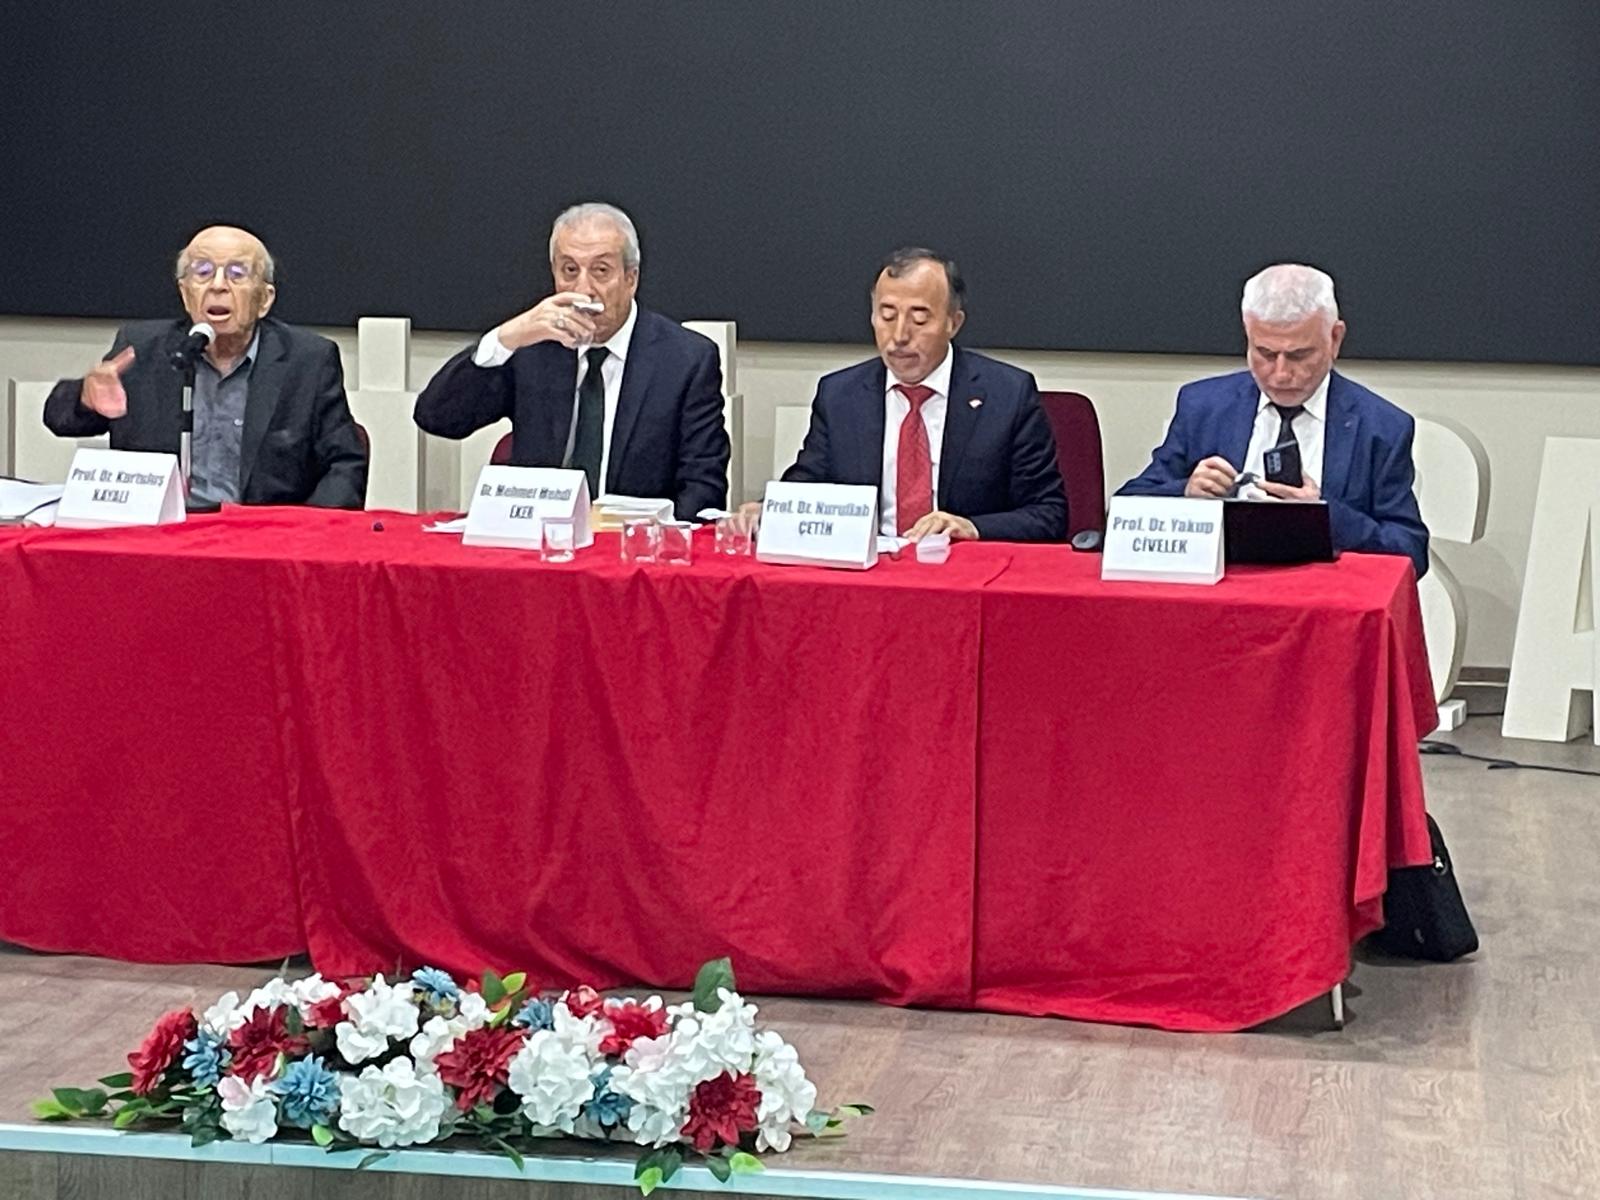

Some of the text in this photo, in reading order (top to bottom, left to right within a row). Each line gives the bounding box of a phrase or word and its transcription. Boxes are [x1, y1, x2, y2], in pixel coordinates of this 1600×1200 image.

[766, 499, 794, 514] Prof.
[797, 500, 812, 515] Dr.
[1112, 516, 1214, 534] Prof. Dr. Yakup
[1132, 536, 1188, 554] CİVELEK
